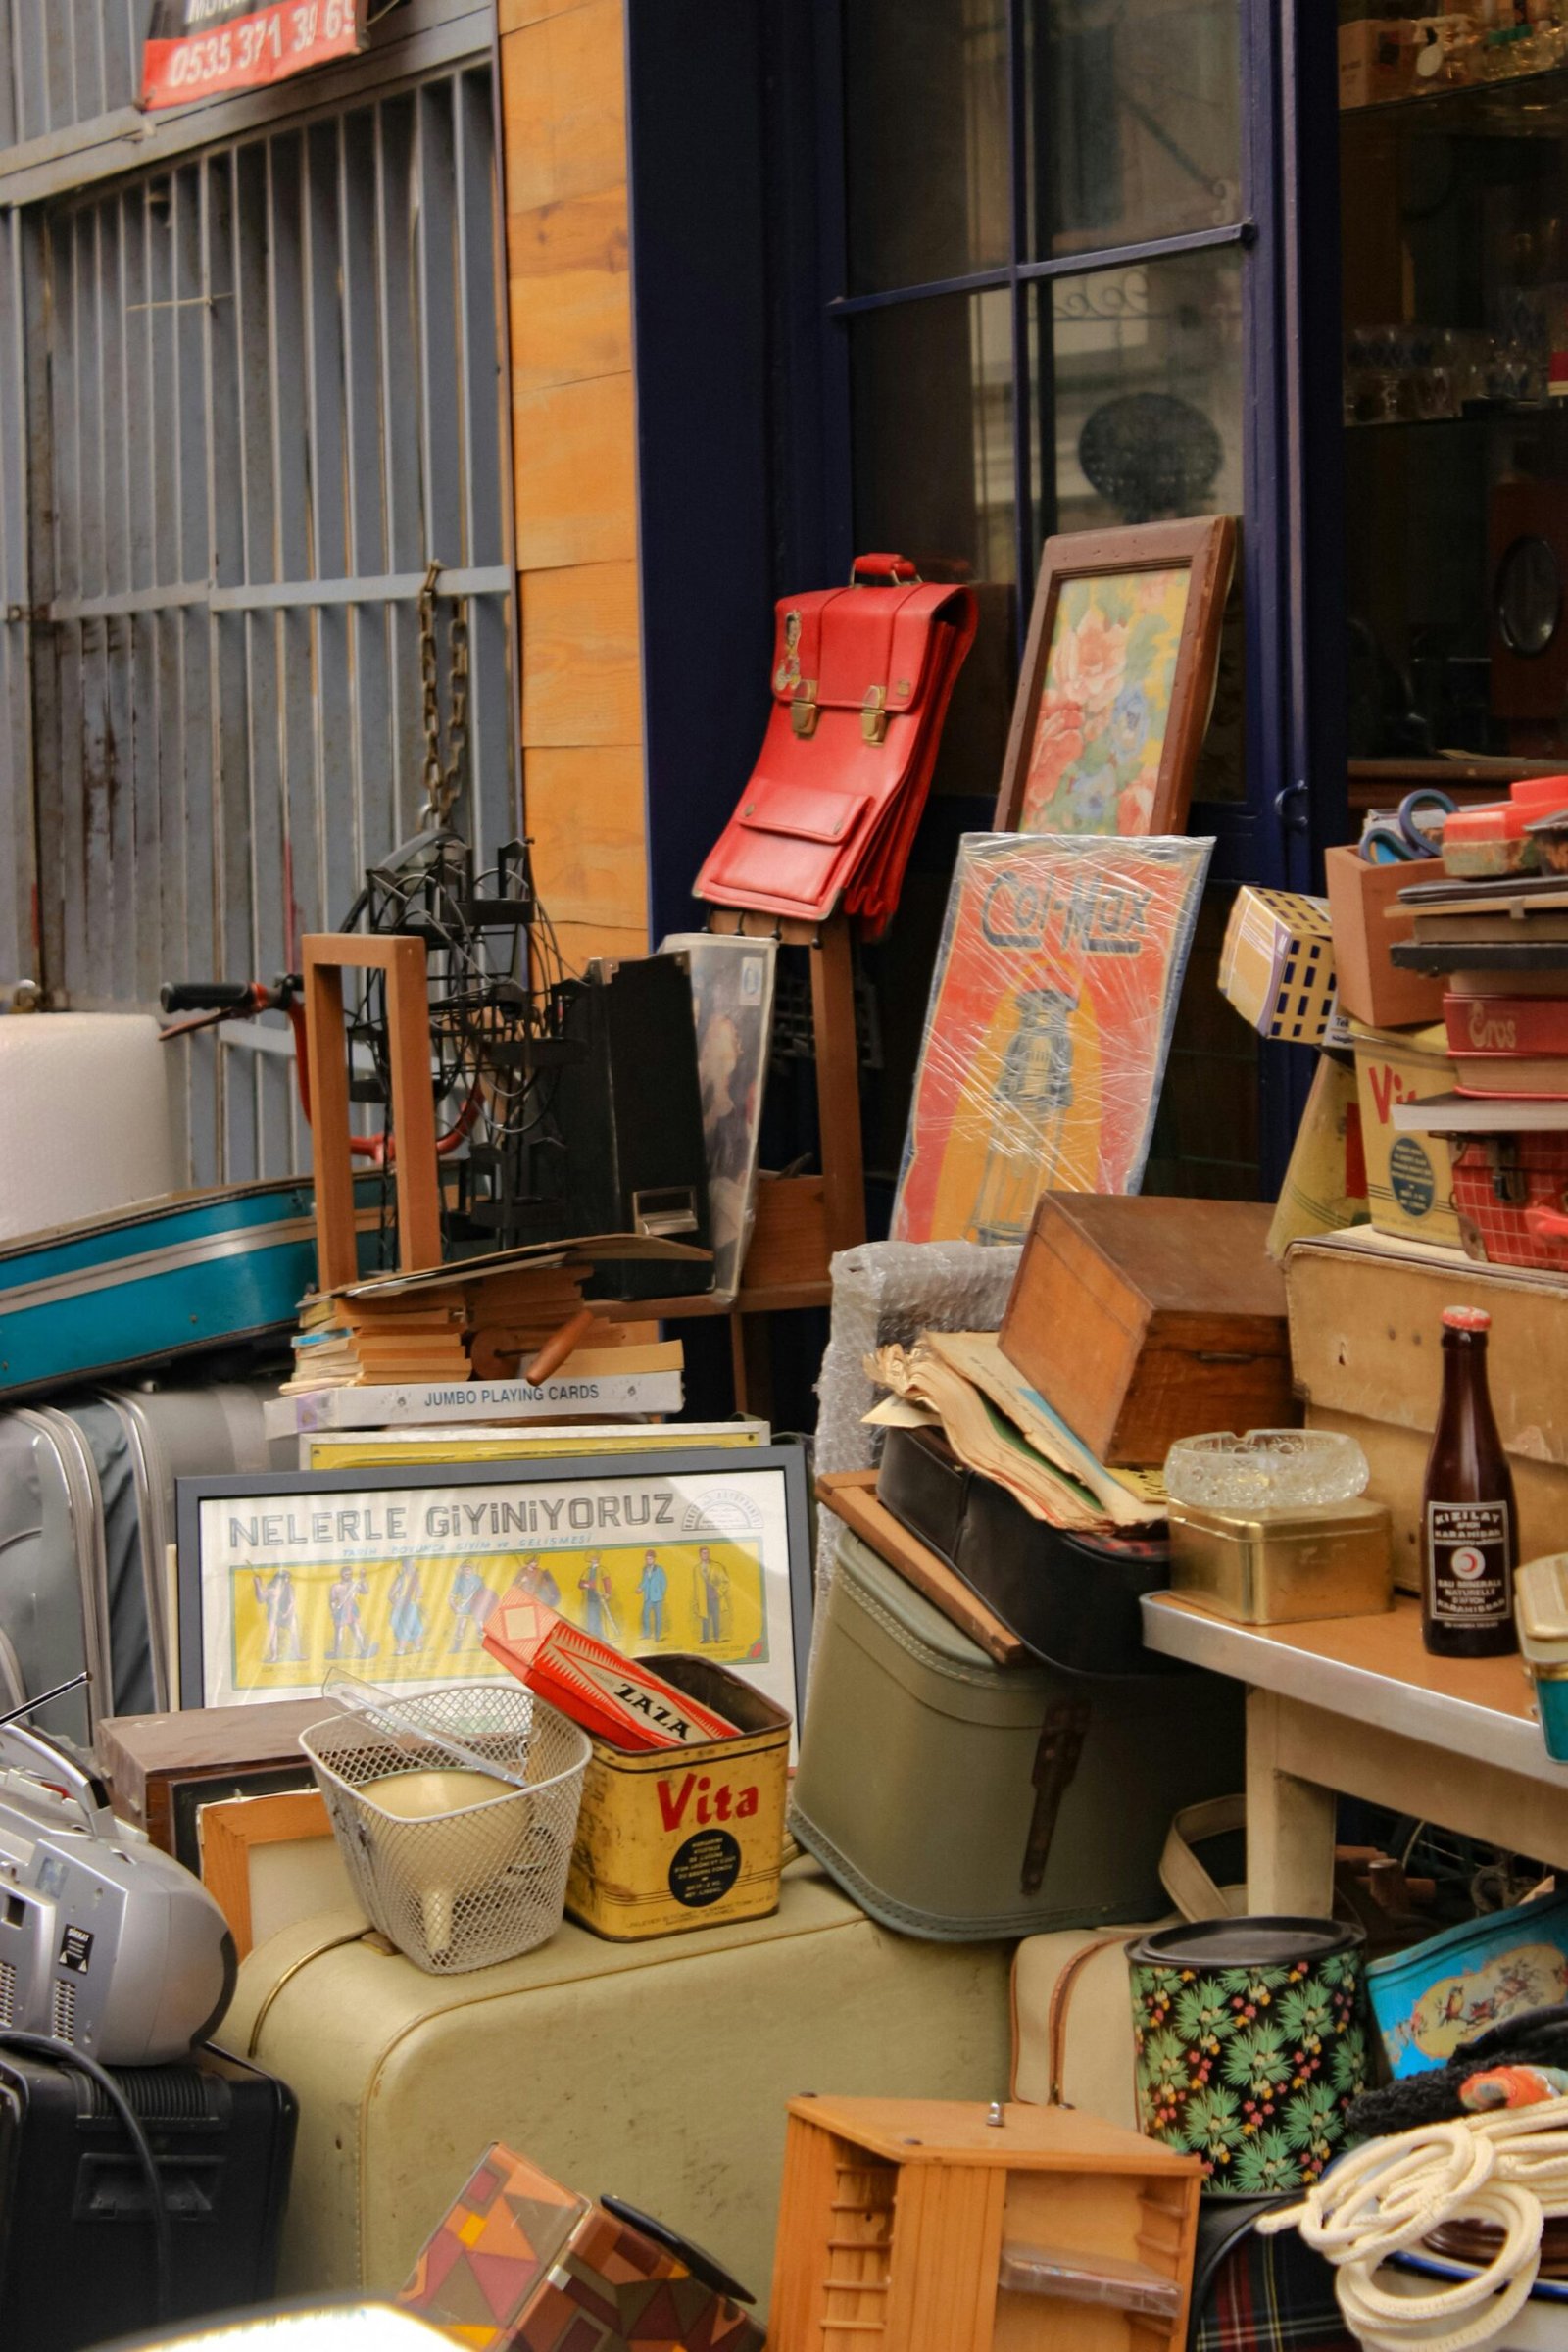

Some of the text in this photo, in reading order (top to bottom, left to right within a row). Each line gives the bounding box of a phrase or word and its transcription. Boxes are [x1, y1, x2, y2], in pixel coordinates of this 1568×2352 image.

[168, 30, 232, 88] 0535
[237, 13, 283, 69] 371
[424, 1384, 600, 1407] JUMBO PLAYING CARDS
[229, 1507, 408, 1548] NELERLE
[613, 1683, 691, 1741] ZAZA
[656, 1772, 759, 1833] Vita
